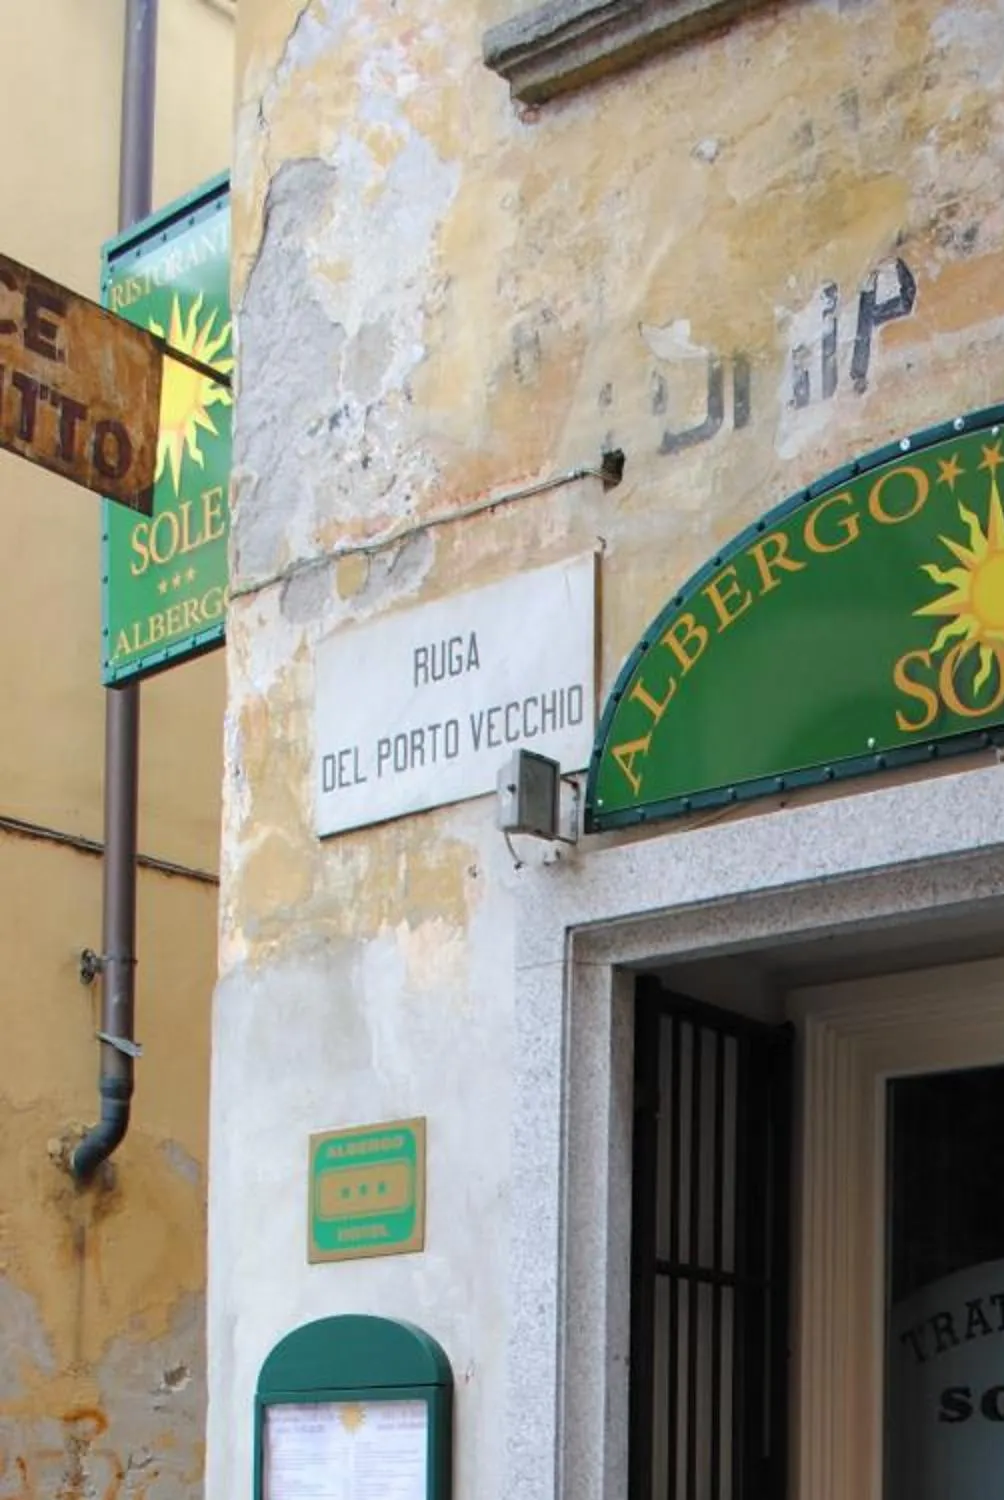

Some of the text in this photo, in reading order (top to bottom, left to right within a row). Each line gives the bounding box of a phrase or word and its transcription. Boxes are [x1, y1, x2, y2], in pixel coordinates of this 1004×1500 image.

[0, 365, 134, 479] TTO
[131, 486, 225, 577] SOLE
[413, 631, 481, 687] RUGA
[611, 465, 930, 797] ALBERGO
[321, 684, 584, 793] DEL PORTO VECCHIO
